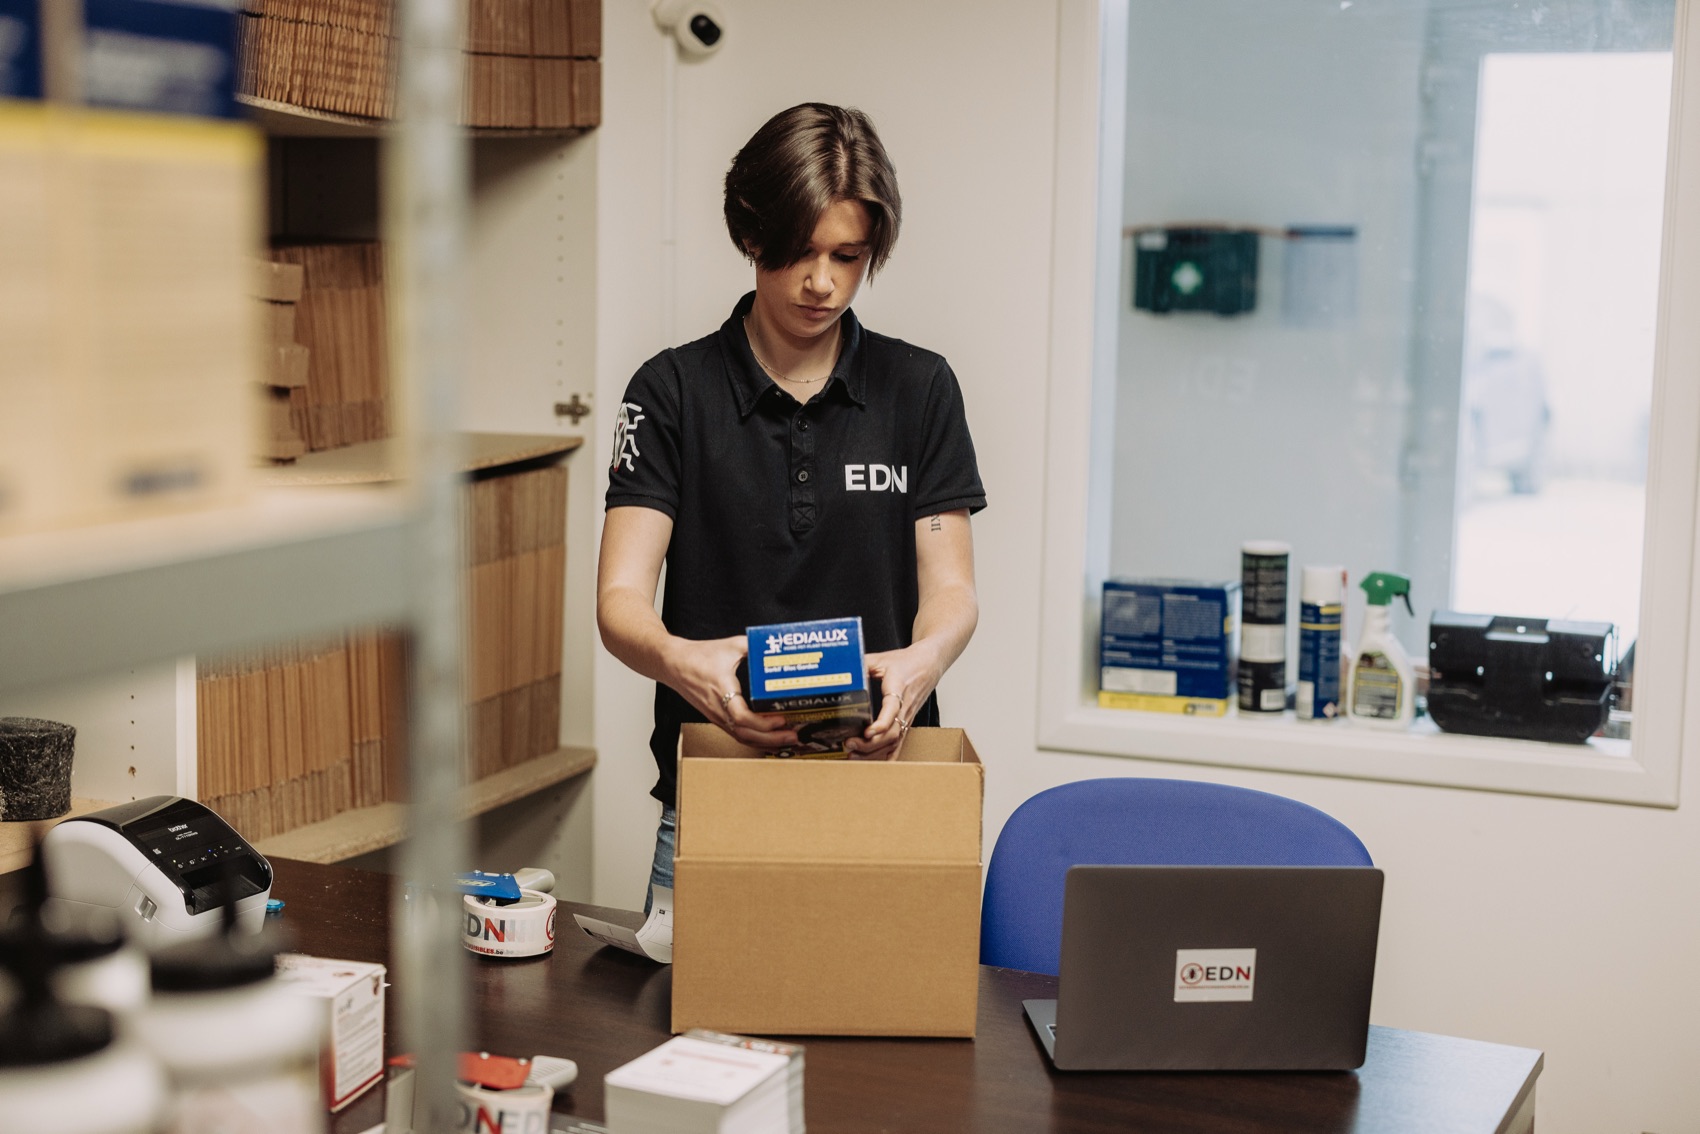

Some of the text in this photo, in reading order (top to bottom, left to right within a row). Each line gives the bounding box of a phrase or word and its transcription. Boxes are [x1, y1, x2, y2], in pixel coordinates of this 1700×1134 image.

[845, 464, 907, 493] EDN
[783, 628, 848, 646] EDIALUX
[788, 695, 852, 707] EDIALUX
[461, 911, 505, 943] DN
[1205, 965, 1251, 981] EDN
